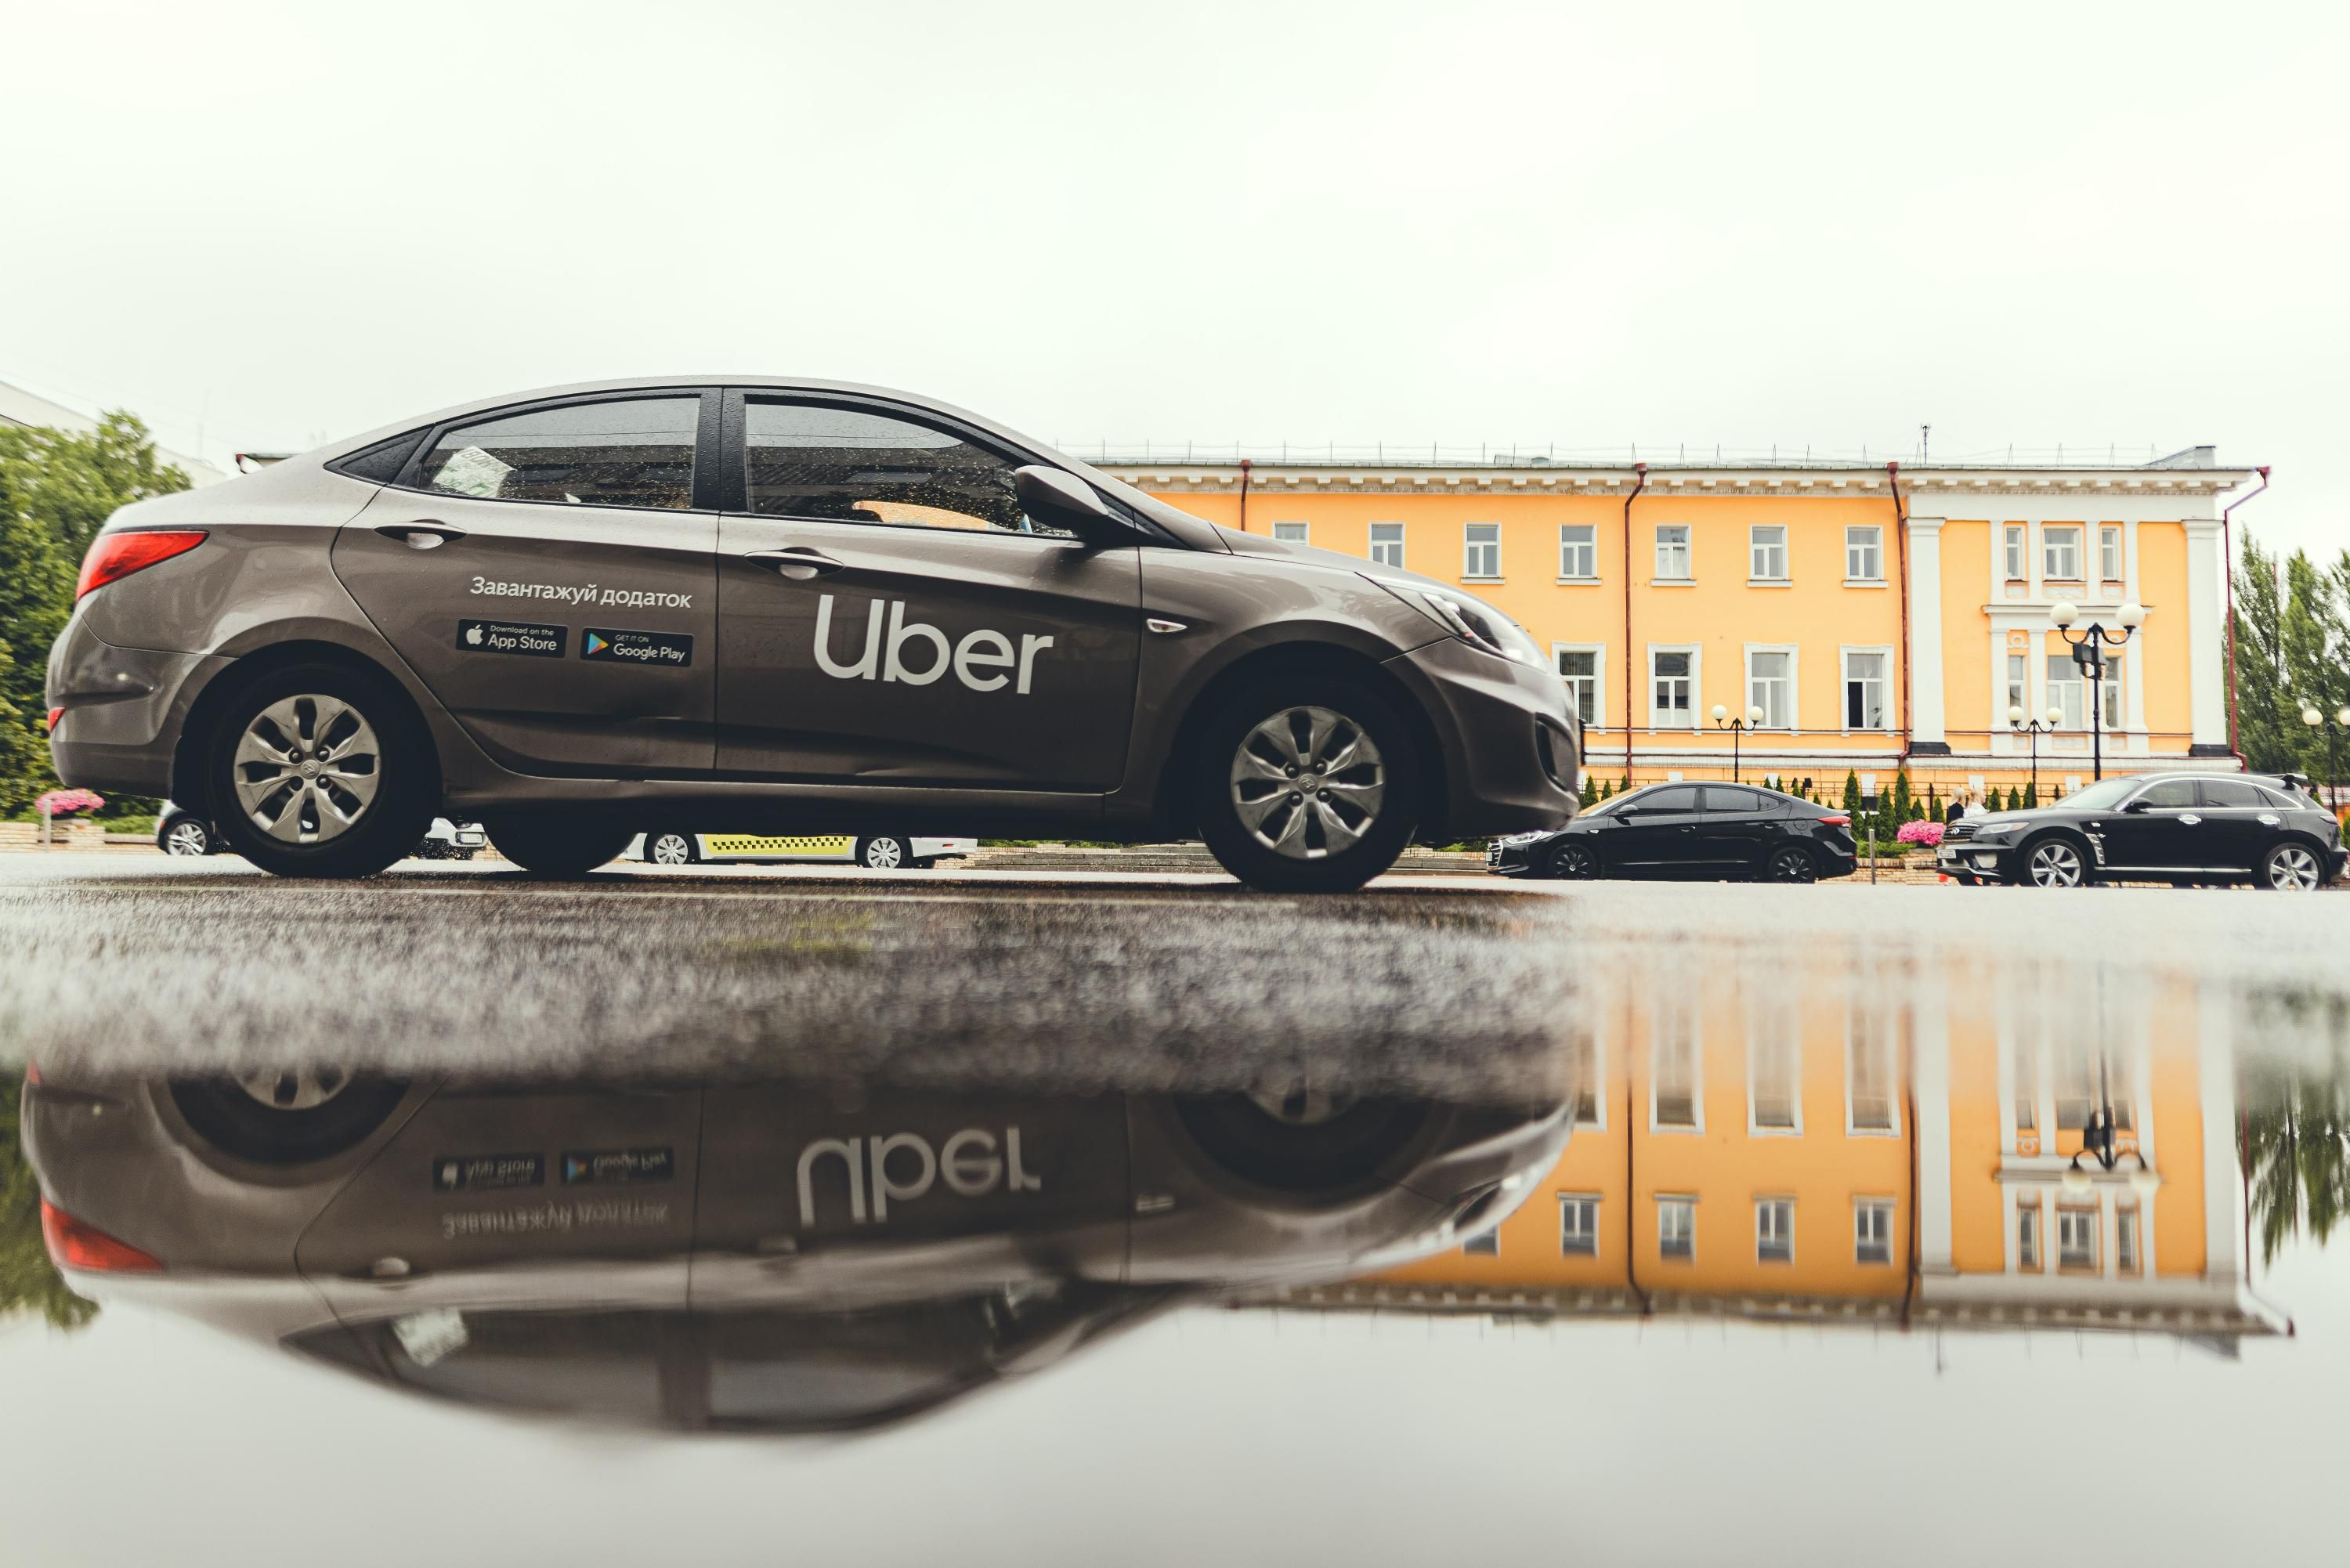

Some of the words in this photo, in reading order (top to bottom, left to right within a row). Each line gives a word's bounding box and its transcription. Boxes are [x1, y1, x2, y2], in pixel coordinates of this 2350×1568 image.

[470, 576, 597, 605] Завантажуй
[600, 588, 692, 609] додаток
[490, 625, 529, 634] Download
[487, 634, 517, 650] App
[519, 636, 557, 651] Store
[813, 594, 1054, 694] Uber
[613, 643, 658, 659] Google
[660, 646, 685, 663] Play
